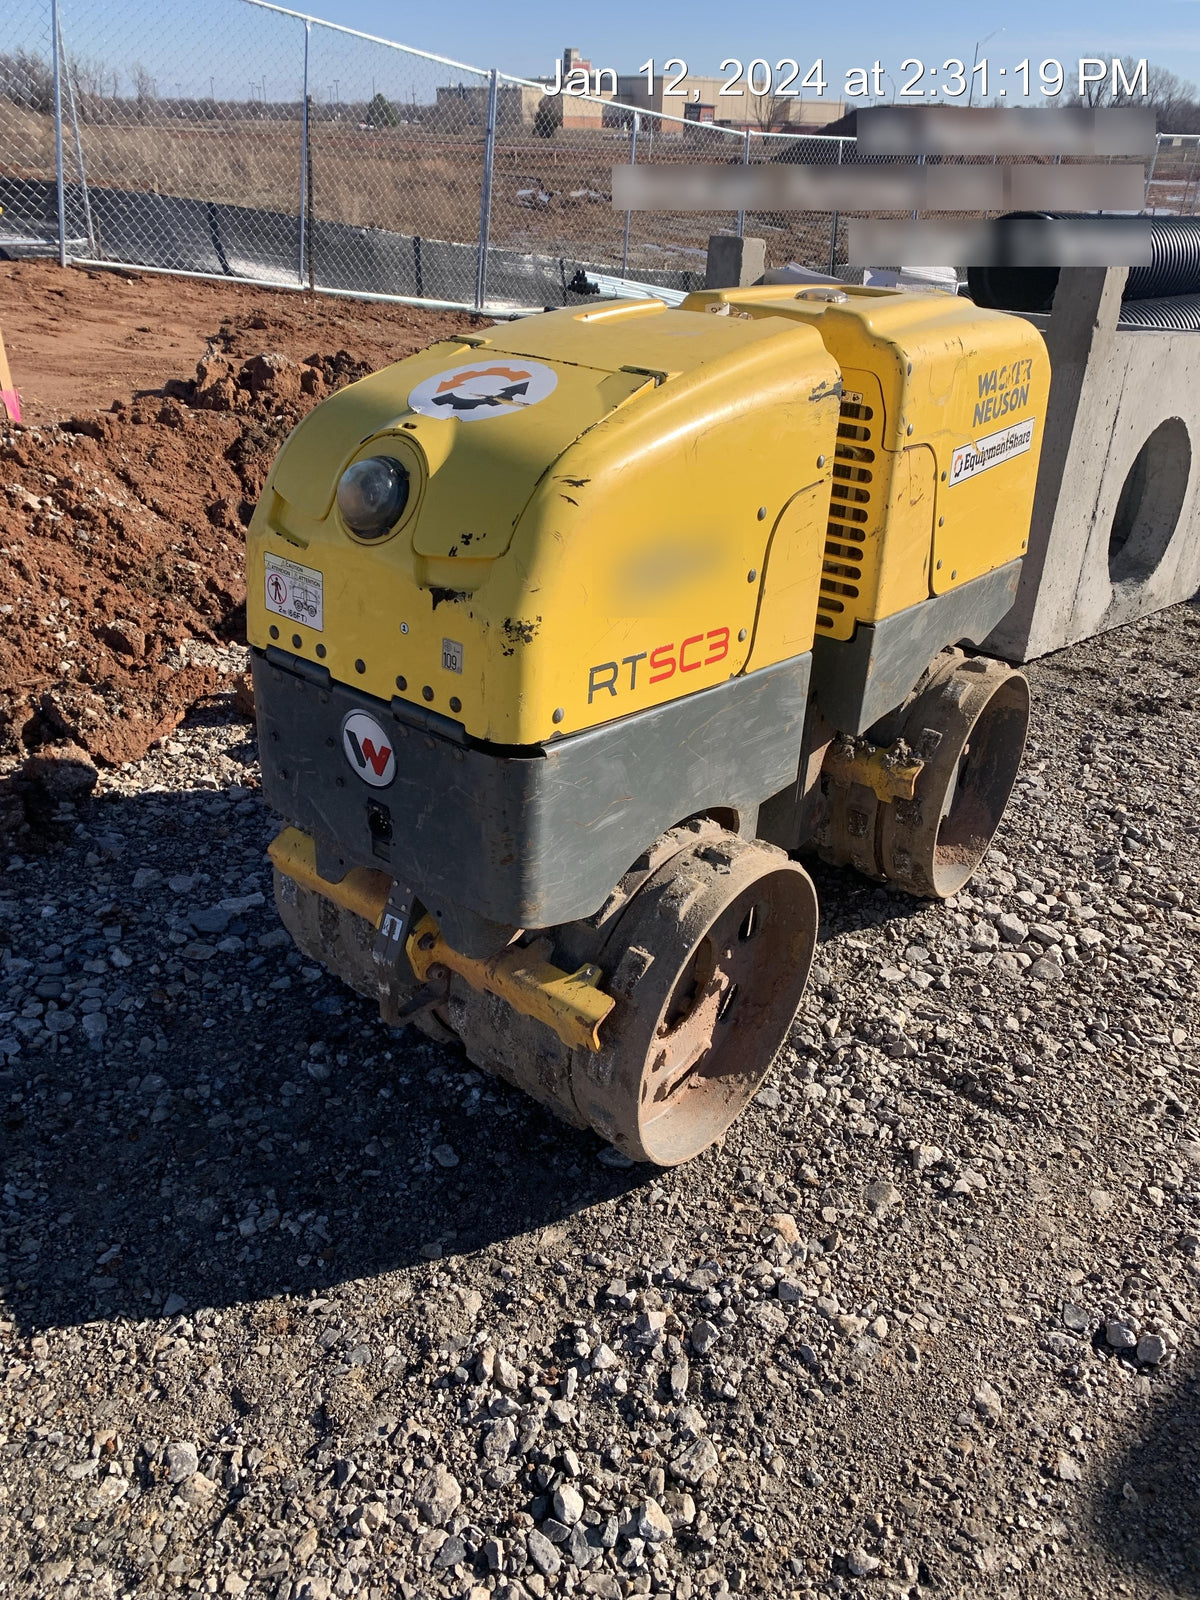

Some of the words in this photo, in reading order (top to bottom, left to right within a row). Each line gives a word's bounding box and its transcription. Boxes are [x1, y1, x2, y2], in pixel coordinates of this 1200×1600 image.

[971, 383, 1031, 428] NEUSON
[963, 430, 1031, 472] EquipmentShare
[285, 560, 304, 573] CAUTION
[443, 651, 458, 671] 109
[587, 626, 730, 705] RTSC3
